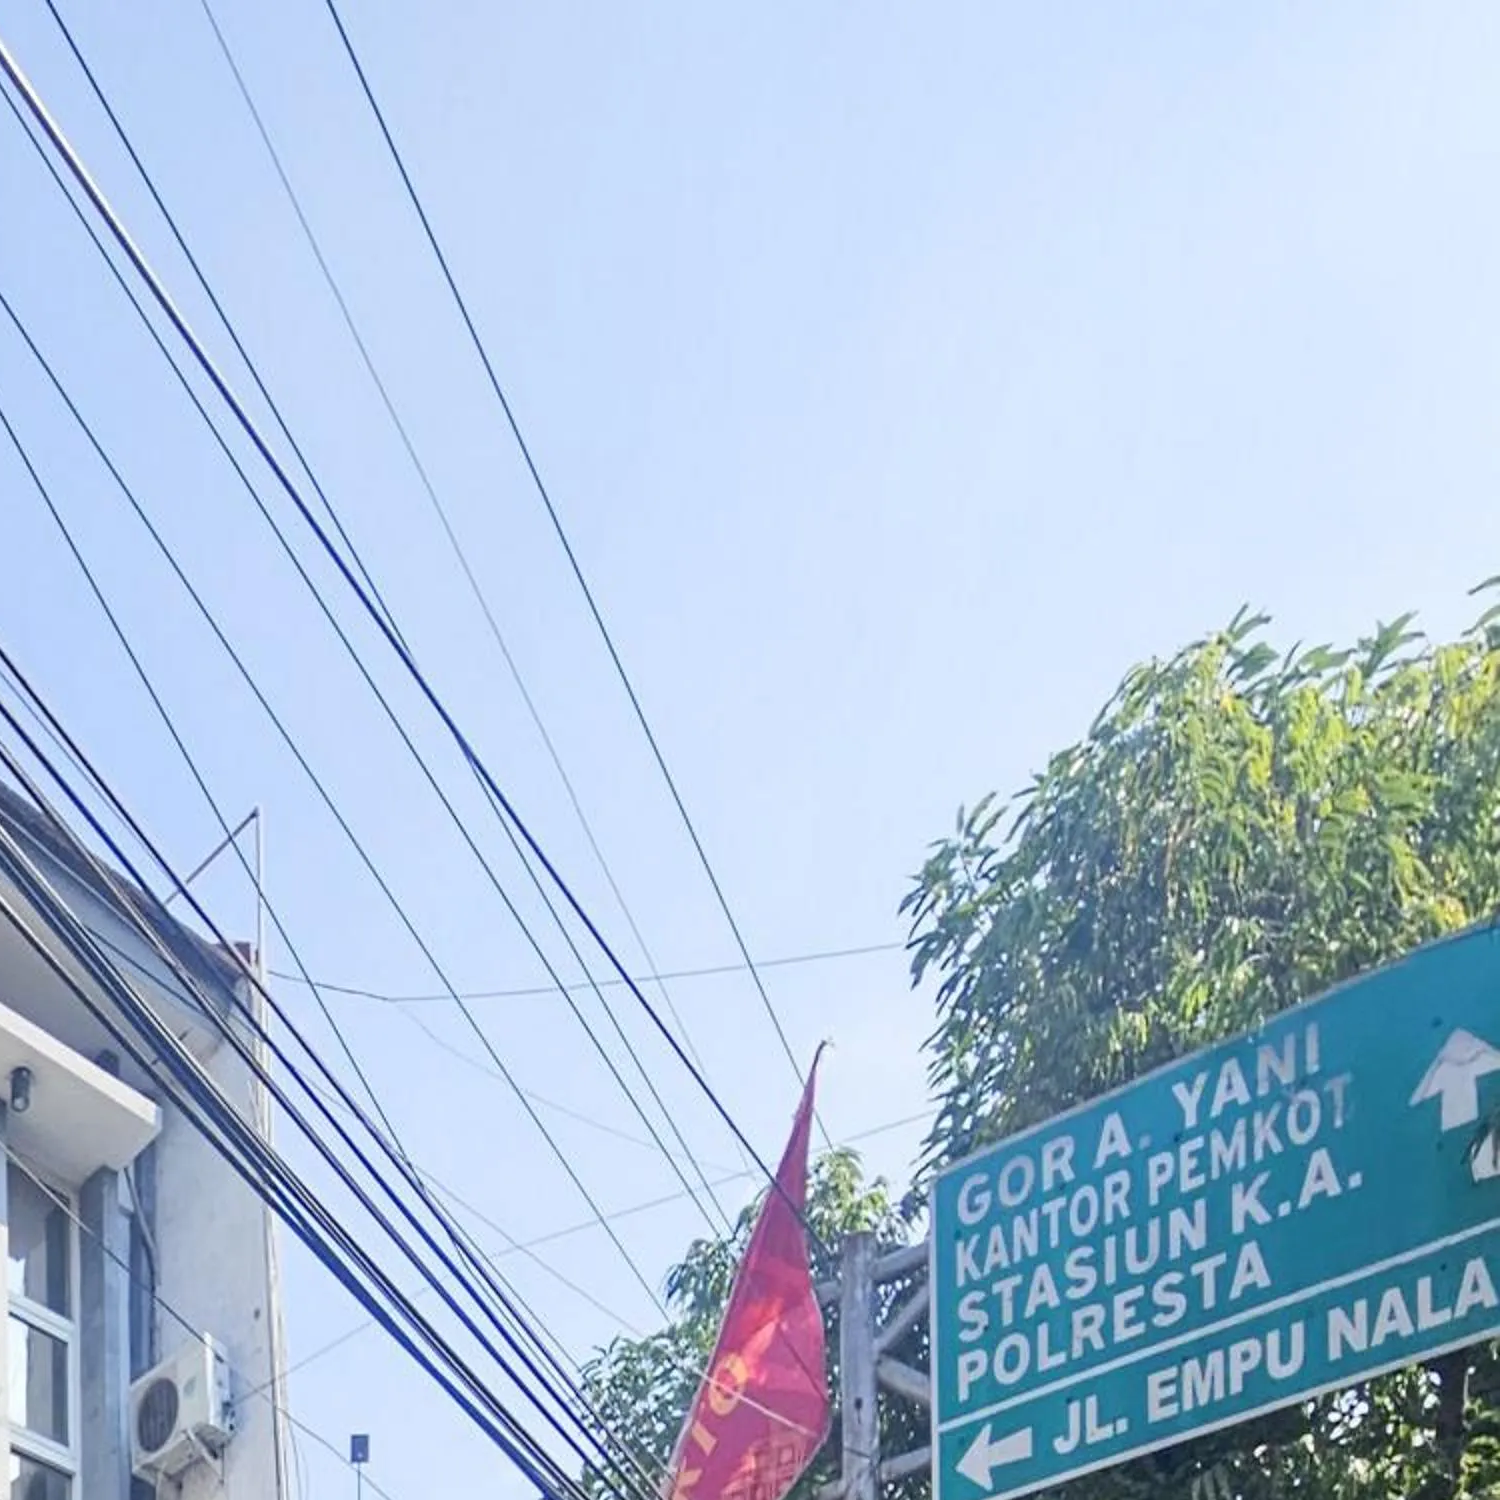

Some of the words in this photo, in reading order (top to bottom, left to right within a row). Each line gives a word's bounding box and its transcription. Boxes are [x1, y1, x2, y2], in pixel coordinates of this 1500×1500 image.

[955, 1170, 1131, 1287] KANTOR
[1147, 1074, 1353, 1206] PEMKOT
[957, 1134, 1074, 1225] GOR
[1172, 1022, 1322, 1129] YANI
[957, 1241, 1272, 1402] POLRESTA
[958, 1198, 1208, 1344] STASIUN
[1230, 1147, 1364, 1236] K.A.
[1053, 1397, 1128, 1456] JL.
[1147, 1323, 1305, 1424] EMPU
[1328, 1257, 1500, 1362] NALA
